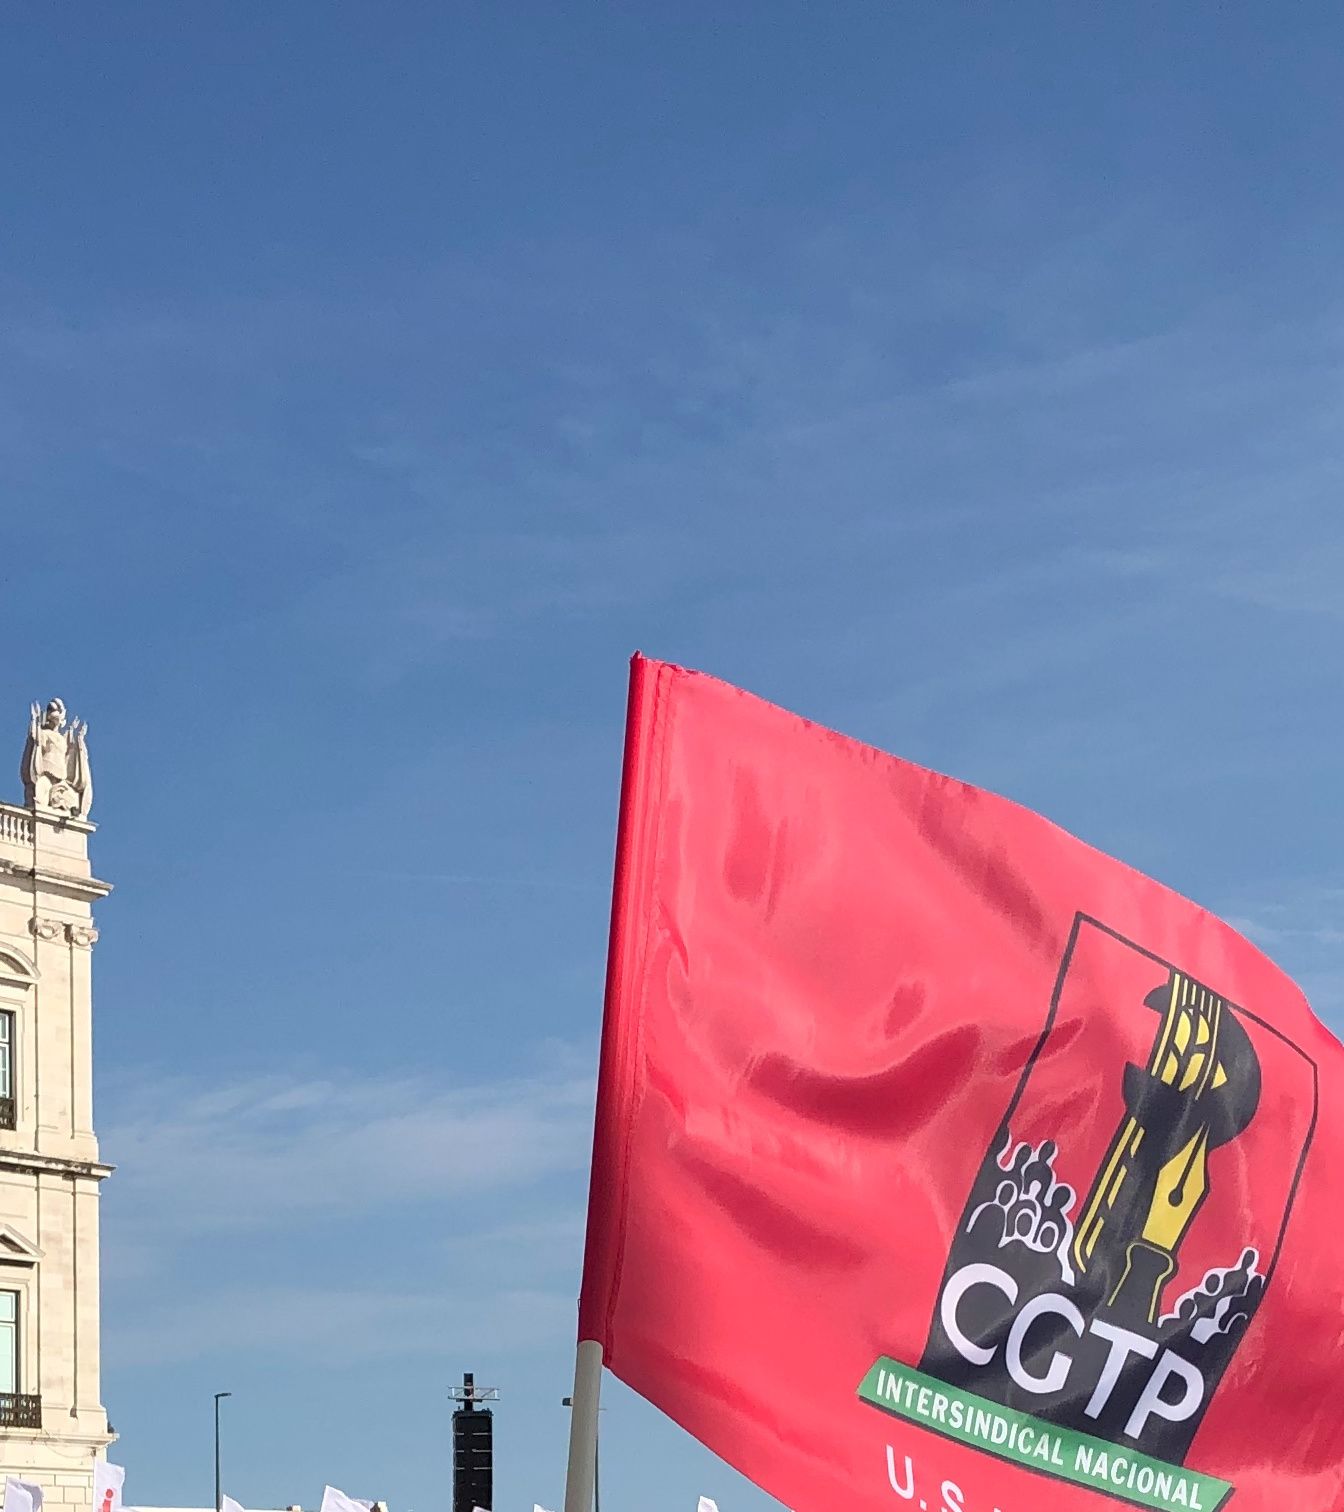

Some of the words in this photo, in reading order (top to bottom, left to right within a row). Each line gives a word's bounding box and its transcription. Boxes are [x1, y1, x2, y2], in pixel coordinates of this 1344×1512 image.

[940, 1262, 1206, 1440] CGTP
[875, 1369, 1064, 1466] INTERSINDICAL
[1074, 1447, 1204, 1512] NACIONAL
[885, 1444, 928, 1511] U.
